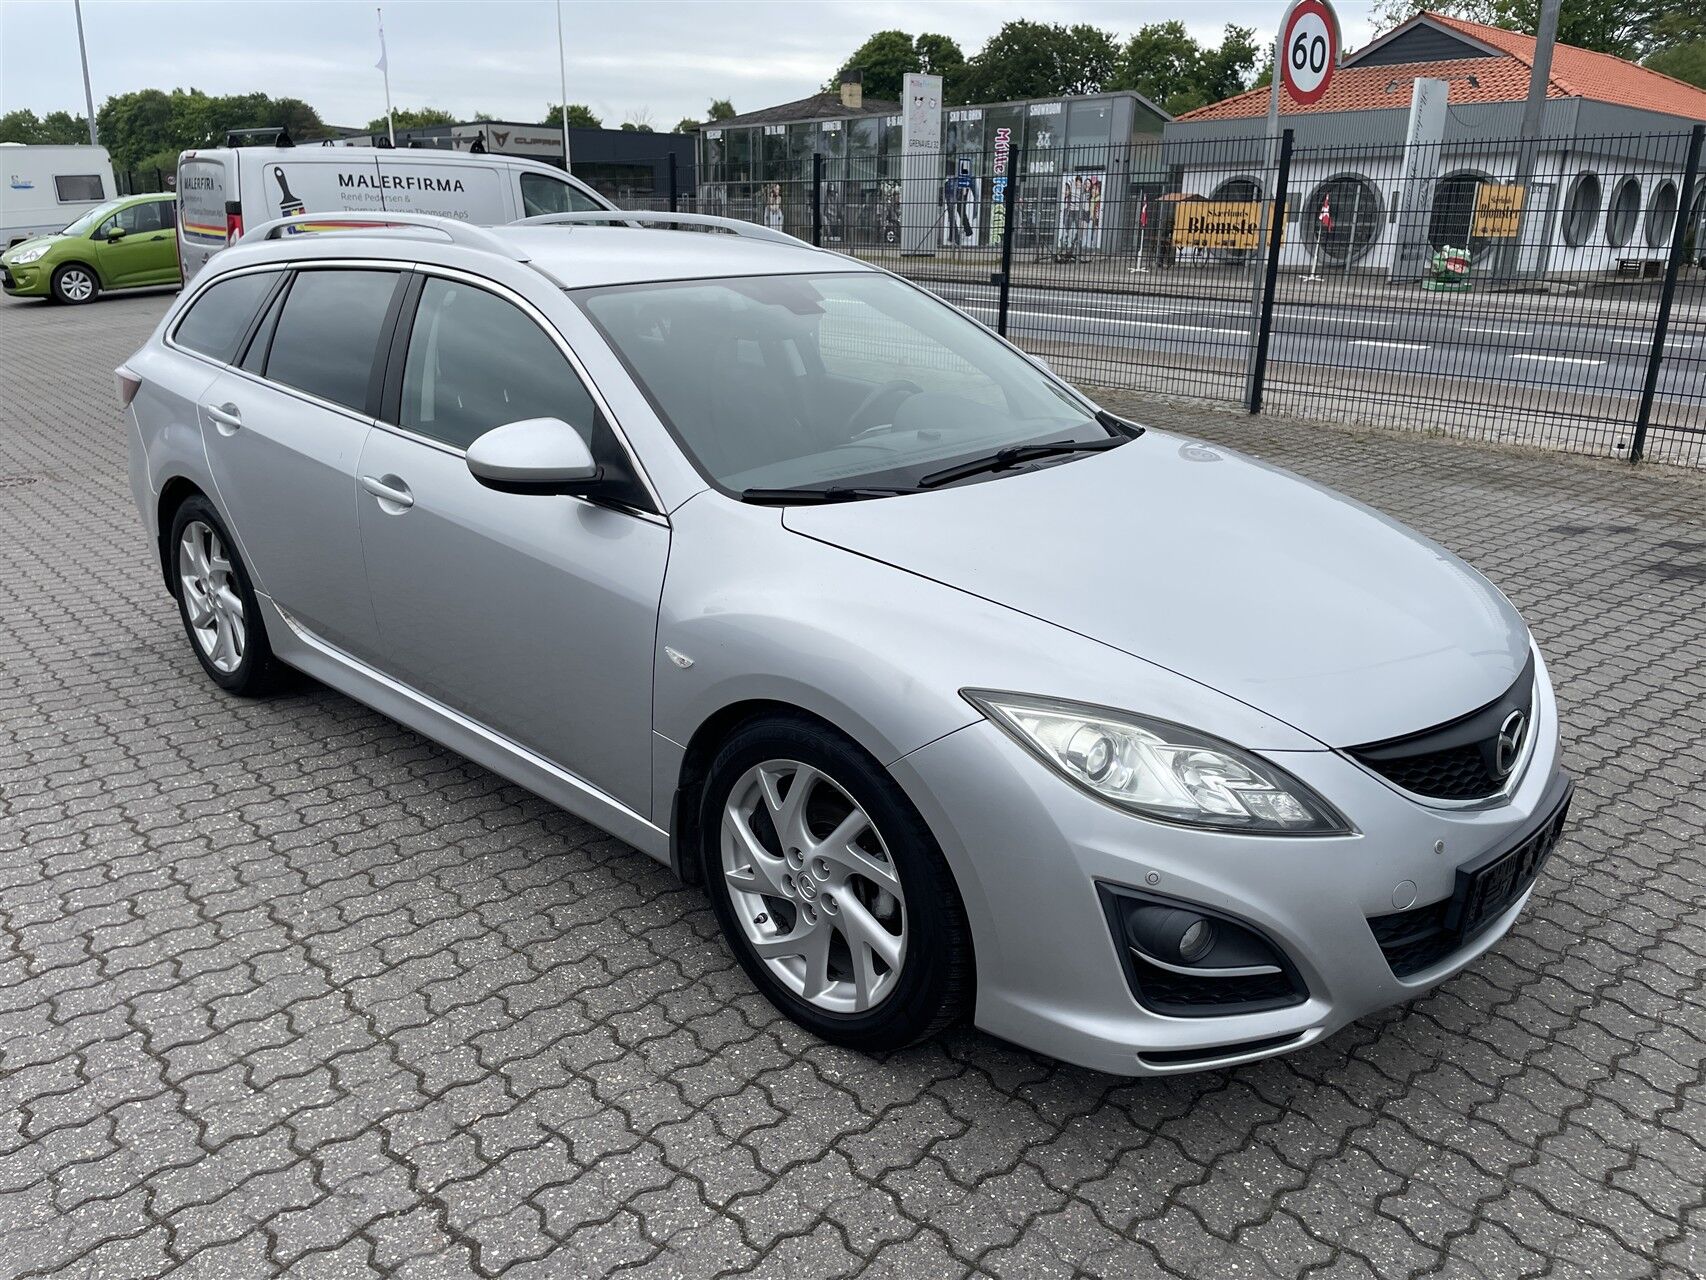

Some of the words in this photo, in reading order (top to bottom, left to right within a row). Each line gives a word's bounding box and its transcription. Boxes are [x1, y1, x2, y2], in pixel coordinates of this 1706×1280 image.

[1292, 31, 1326, 73] 60
[514, 137, 561, 147] CUPRA
[337, 173, 465, 193] MALERFIRMA
[341, 191, 363, 202] René
[453, 210, 469, 219] ApS
[1188, 216, 1258, 235] Blomste
